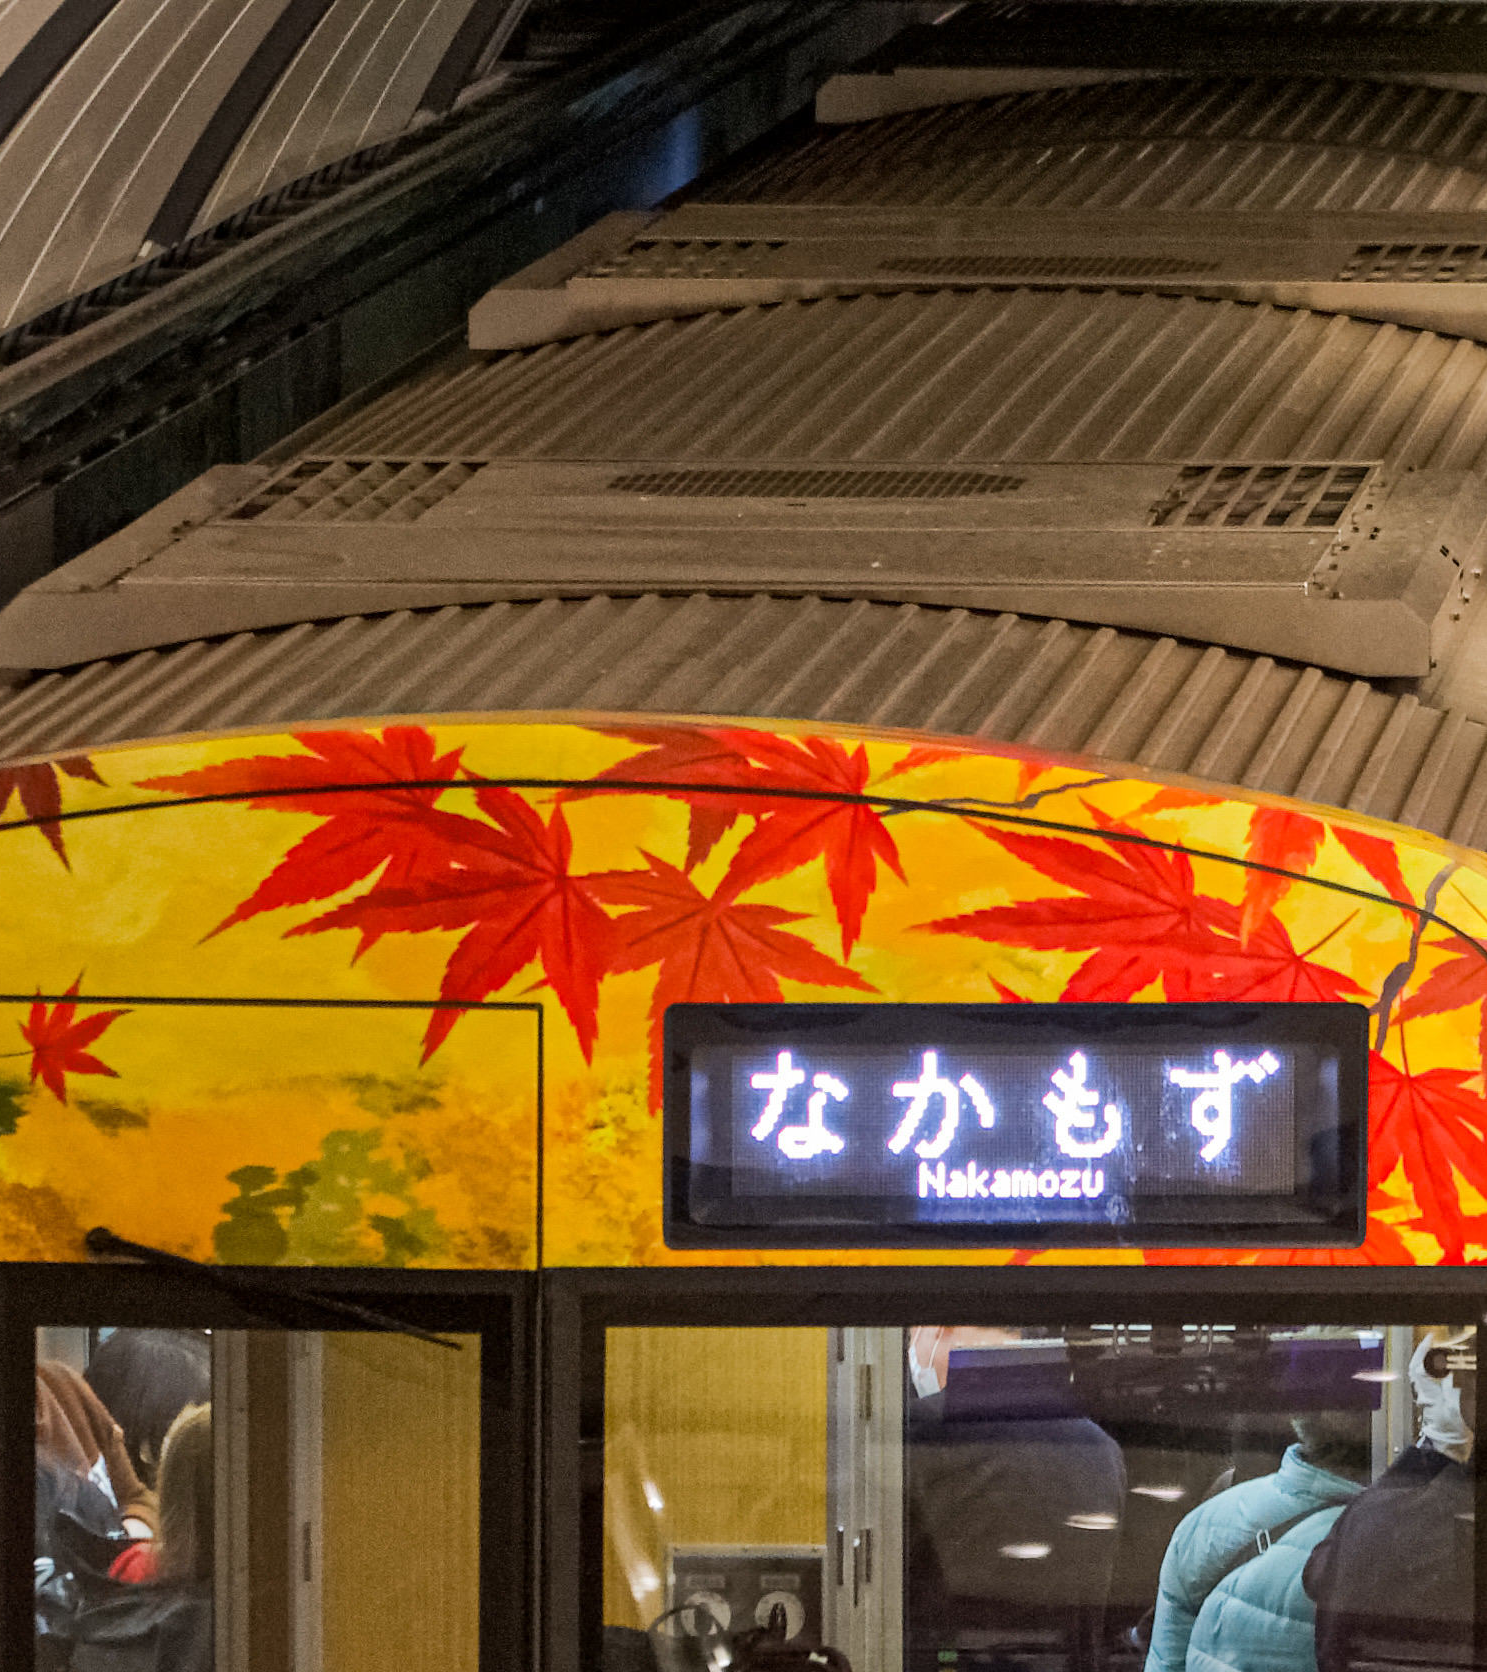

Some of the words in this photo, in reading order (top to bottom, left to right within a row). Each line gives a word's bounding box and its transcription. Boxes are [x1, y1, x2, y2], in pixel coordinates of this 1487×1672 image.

[749, 1049, 1282, 1161] なかもず
[917, 1160, 1107, 1199] Nakamozu
